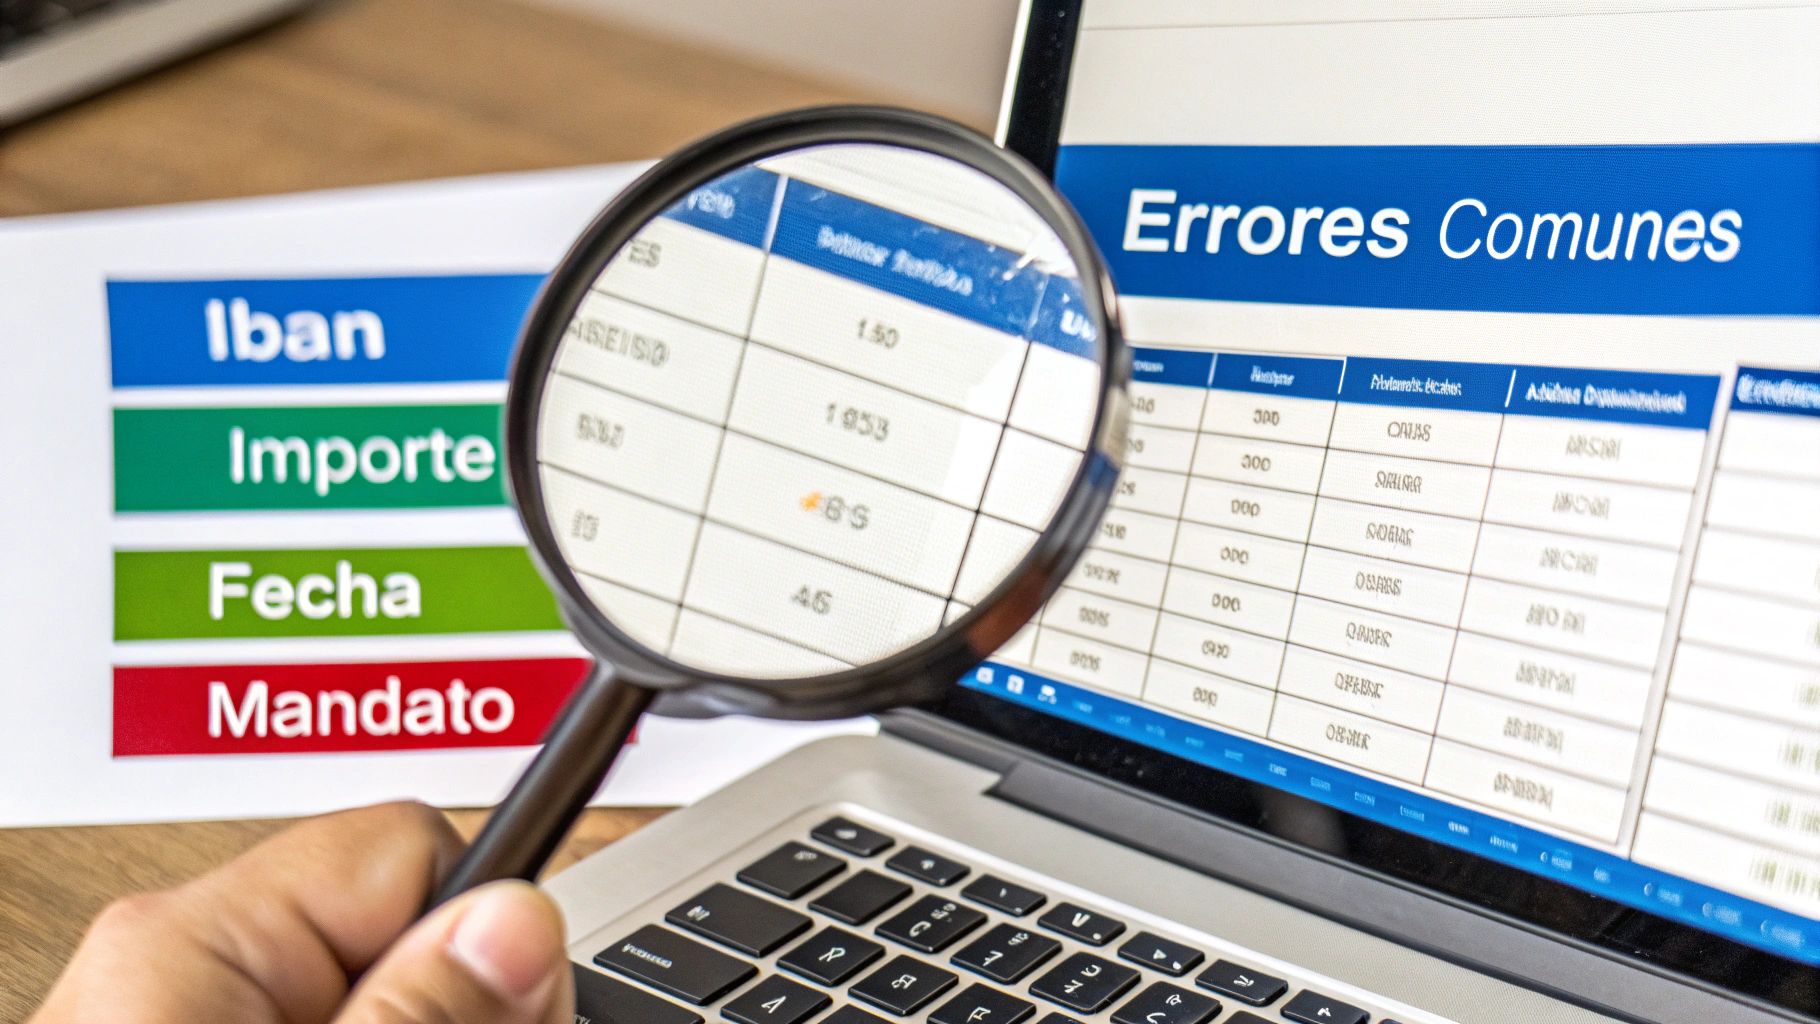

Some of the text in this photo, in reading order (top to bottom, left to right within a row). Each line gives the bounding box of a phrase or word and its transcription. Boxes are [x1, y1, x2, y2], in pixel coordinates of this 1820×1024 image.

[1122, 188, 1742, 262] Errores Comunes
[204, 297, 386, 362] Iban
[229, 426, 496, 497] Importe
[208, 560, 422, 620] Fecha
[208, 676, 515, 738] Mandato
